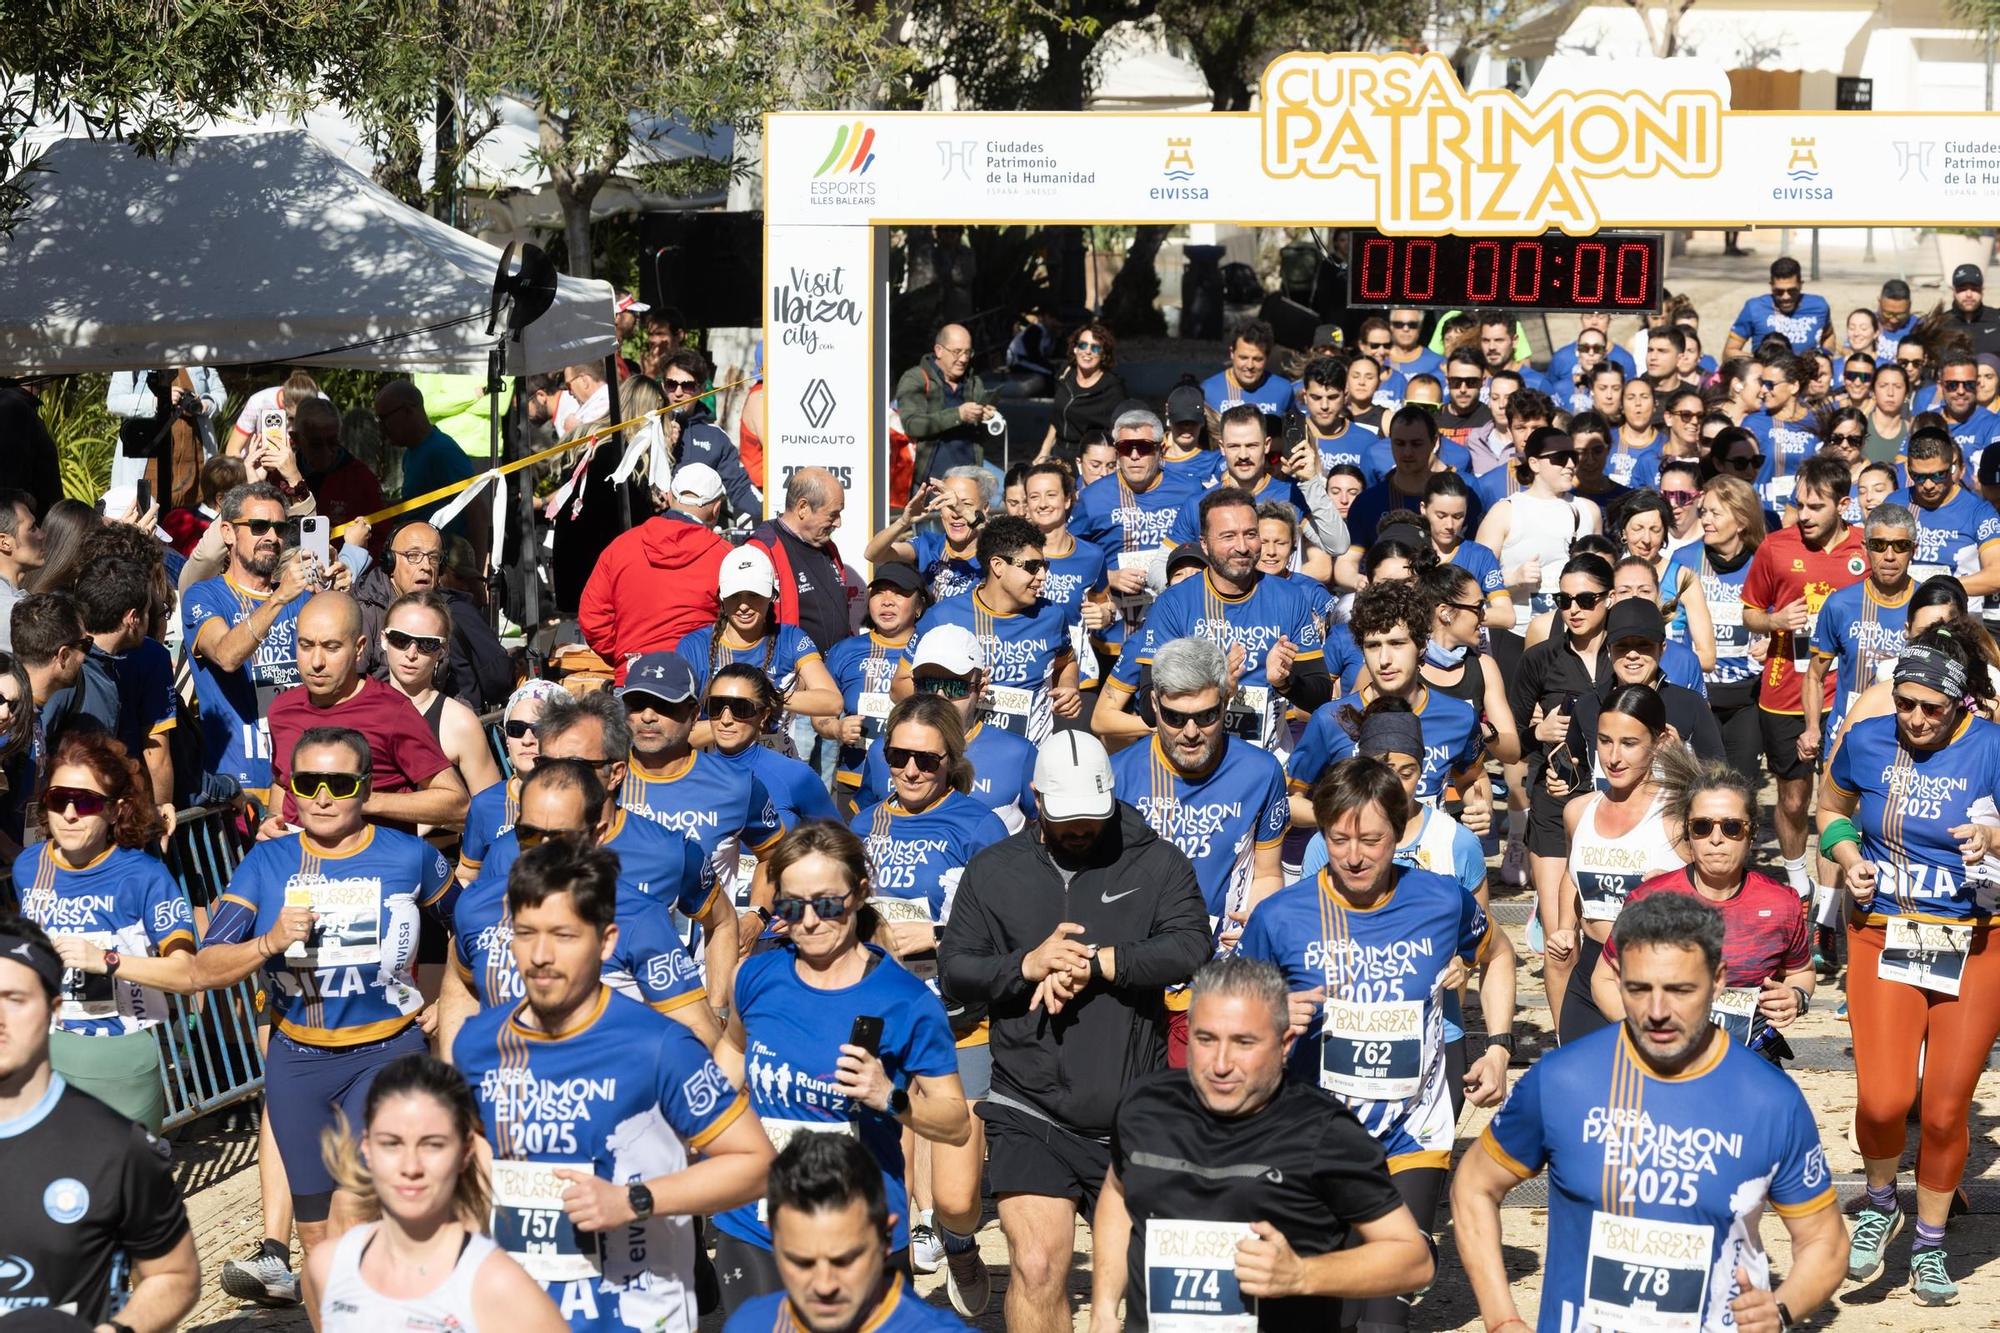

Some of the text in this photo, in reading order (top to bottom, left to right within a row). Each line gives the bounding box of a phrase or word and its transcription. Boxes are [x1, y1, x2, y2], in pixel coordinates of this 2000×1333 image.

[1277, 69, 1451, 107] CURSA
[1277, 105, 1706, 164] PATRIMONI
[986, 141, 1044, 153] Ciudades
[986, 156, 1057, 168] Patrimonio
[811, 182, 876, 195] ESPORTS
[986, 172, 1096, 184] de la Humanidad
[1944, 173, 1960, 184] de
[1965, 173, 1977, 184] la
[810, 197, 876, 205] ILLES BALEARS
[1149, 186, 1209, 200] eivissa
[1391, 163, 1583, 221] IBIZA
[1773, 187, 1833, 200] eivissa
[791, 266, 846, 297] Visit
[1467, 241, 1648, 303] 00:00
[774, 285, 862, 326] Ibiza
[783, 323, 819, 354] city
[781, 435, 855, 444] PUNICAUTO
[1194, 625, 1280, 641] PATRIMONI
[1197, 618, 1232, 628] CURSA
[873, 678, 891, 693] 20
[1885, 765, 1918, 777] CURSA
[1881, 772, 1967, 795] PATRIMONI
[1891, 783, 1952, 801] EIVISSA
[1138, 797, 1181, 808] CURSA
[1897, 797, 1941, 820] 2025
[1172, 835, 1211, 859] 025
[1584, 855, 1643, 869] BALANZAT
[289, 874, 327, 882] CURSA
[878, 866, 916, 888] 025
[1595, 875, 1626, 893] 792
[22, 895, 113, 913] PATRIMONI
[1304, 938, 1432, 971] PATRIMONI
[1307, 938, 1357, 953] CURSA
[1325, 959, 1417, 985] EIVISSA
[497, 971, 526, 998] 20
[1340, 978, 1405, 1003] 2025
[1329, 1006, 1418, 1022] TONI COSTA
[1336, 1018, 1414, 1033] BALANZAT
[1351, 1041, 1392, 1065] 762
[484, 1068, 536, 1083] CURSA
[481, 1077, 616, 1102] PATRIMONI
[495, 1099, 591, 1122] EIVISSA
[1588, 1107, 1655, 1128] CURSA
[509, 1123, 577, 1155] 2025
[1583, 1119, 1743, 1158] PATRIMONI
[1604, 1142, 1718, 1175] EIVISSA
[496, 1169, 529, 1183] TONI
[1618, 1168, 1699, 1207] 2025
[518, 1209, 560, 1238] 757
[1153, 1229, 1240, 1245] TONI COST
[1600, 1221, 1706, 1249] TONI COSTA
[1159, 1241, 1236, 1258] BALANZA
[1607, 1236, 1700, 1260] BALANZAT
[1174, 1269, 1220, 1299] 774
[1622, 1263, 1671, 1296] 778
